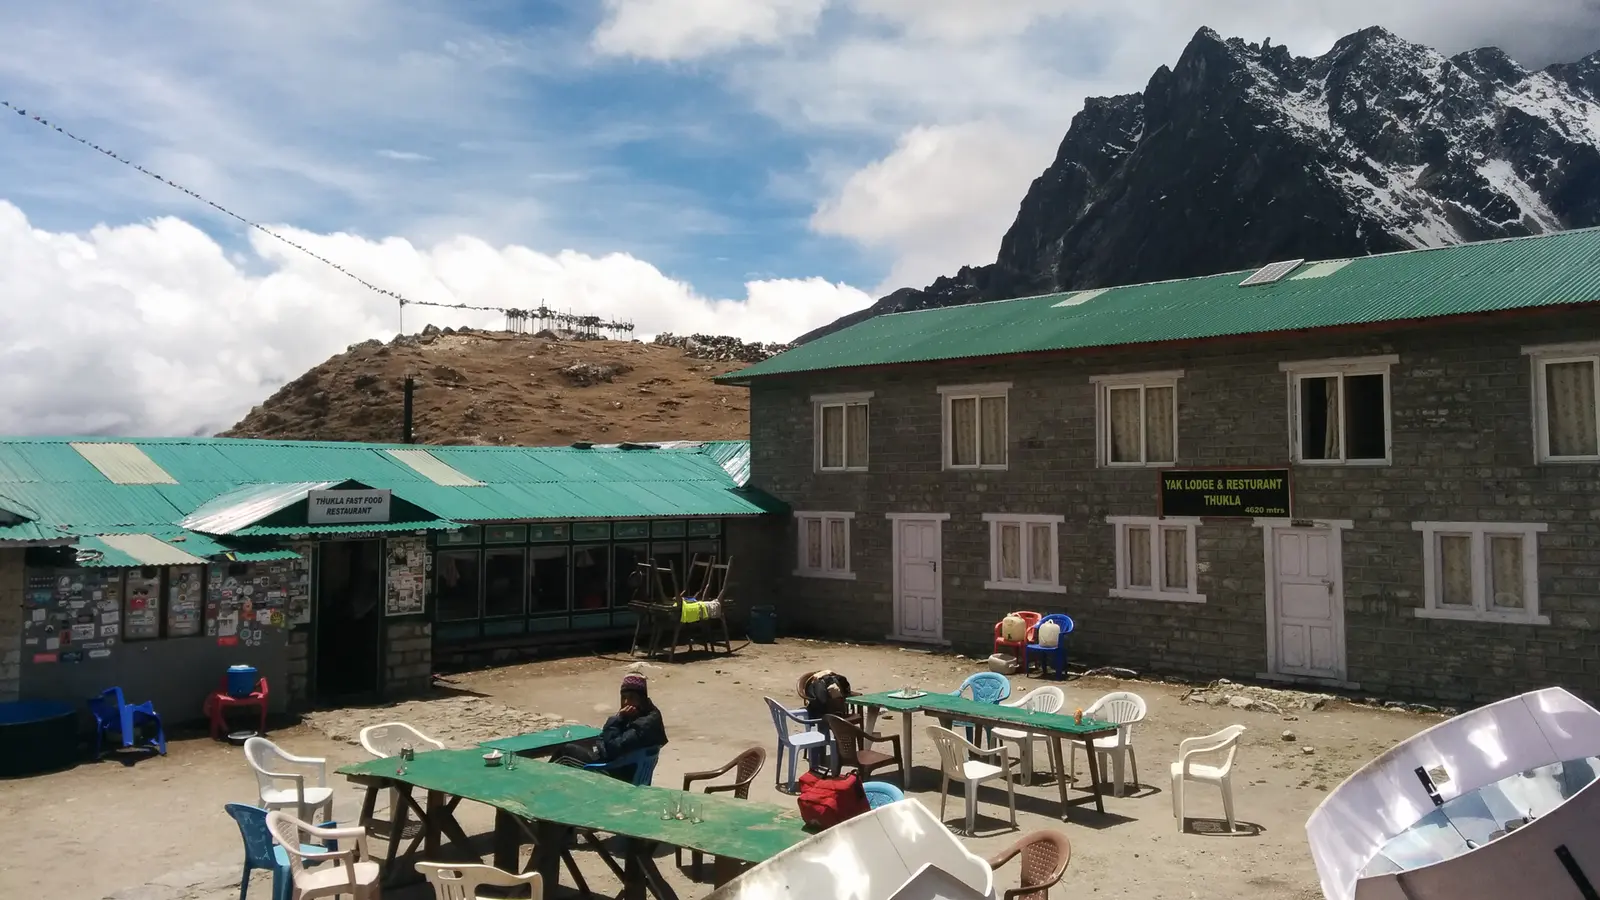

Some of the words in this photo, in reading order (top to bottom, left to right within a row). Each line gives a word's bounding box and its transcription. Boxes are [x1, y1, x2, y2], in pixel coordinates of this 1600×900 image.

[1165, 479, 1182, 490] YAK
[1185, 479, 1214, 490] LODGE
[1217, 479, 1224, 490] &
[1226, 478, 1282, 490] RESTURANT
[316, 497, 344, 505] THUKLA
[345, 497, 362, 505] FAST
[364, 496, 383, 504] FOOD
[1203, 495, 1241, 506] THUKLA
[326, 507, 372, 516] RESTAURANT
[1244, 506, 1264, 514] 4620
[1266, 506, 1285, 514] mtrs
